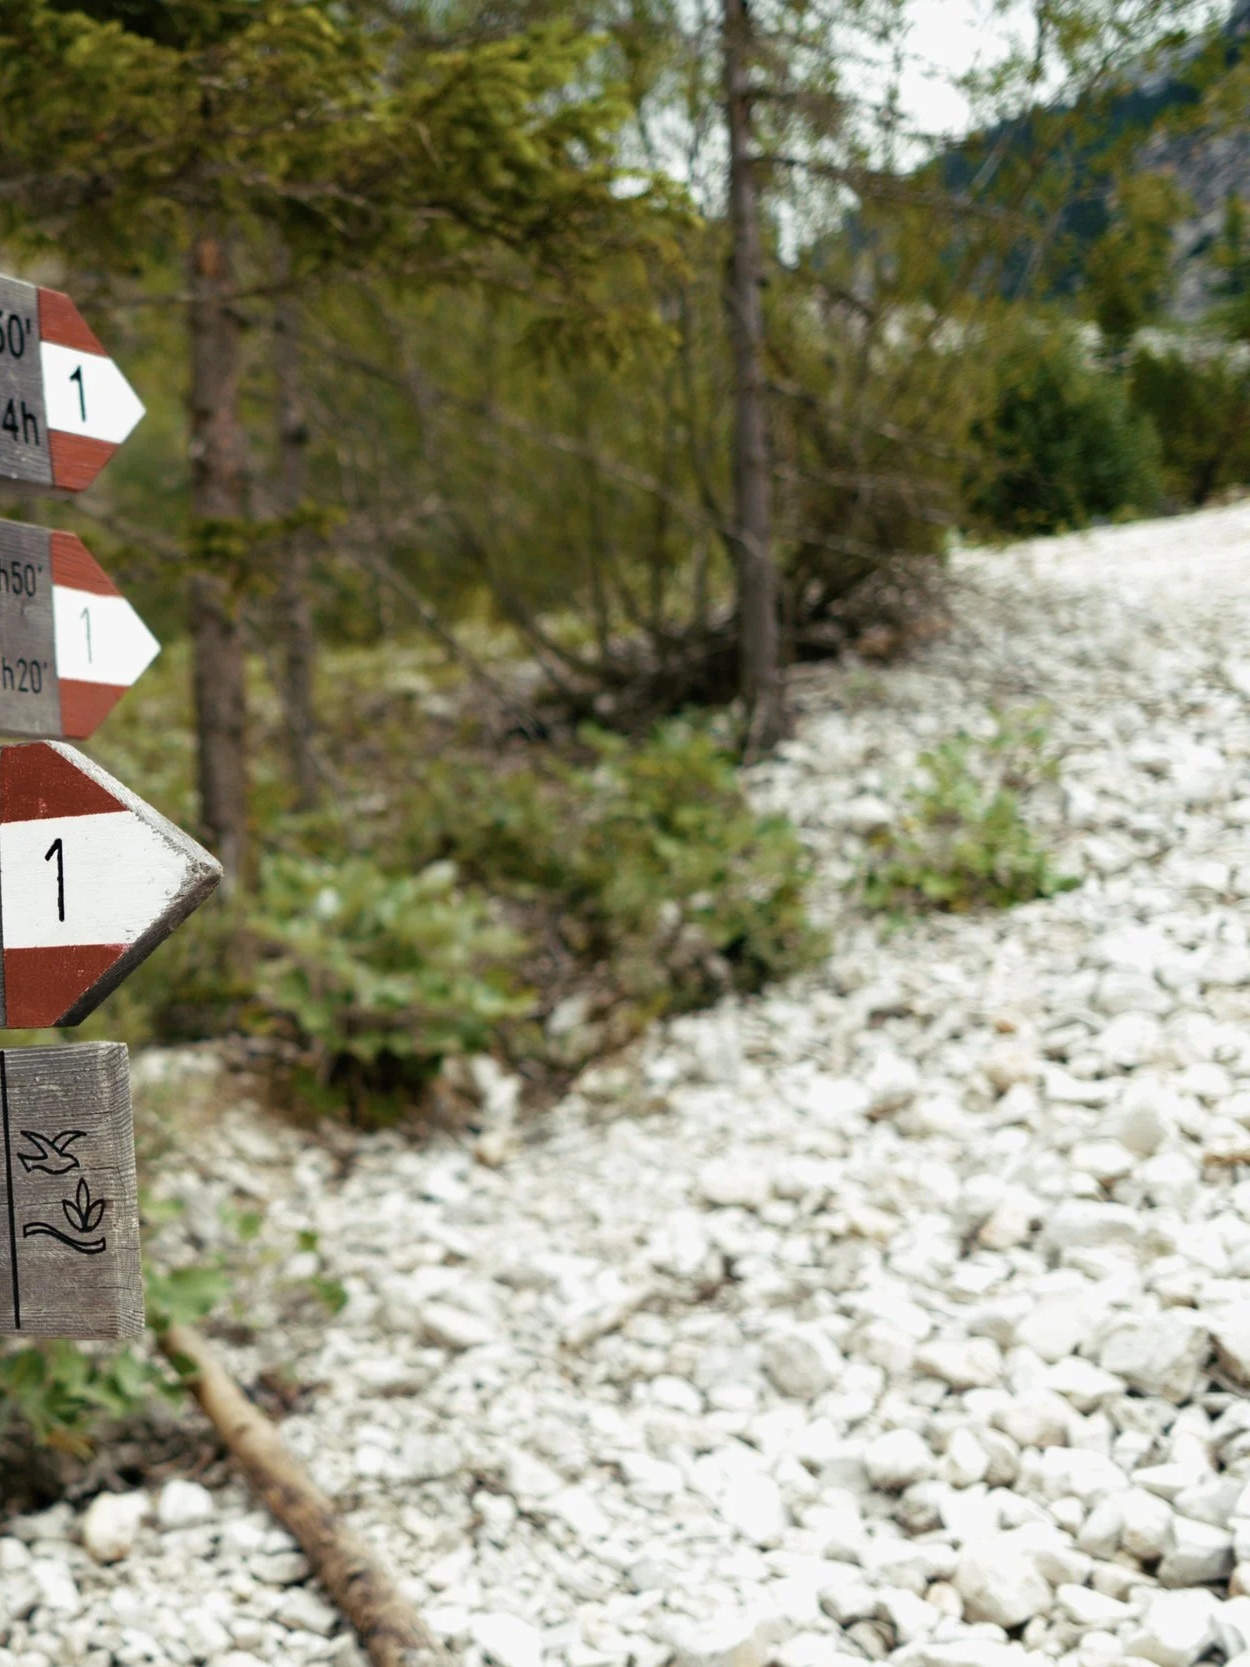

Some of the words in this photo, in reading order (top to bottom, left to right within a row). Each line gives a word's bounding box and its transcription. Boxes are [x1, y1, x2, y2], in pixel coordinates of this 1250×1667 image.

[69, 365, 86, 422] 1
[2, 399, 40, 446] 4h
[80, 607, 93, 664] 1
[44, 838, 65, 922] 1
